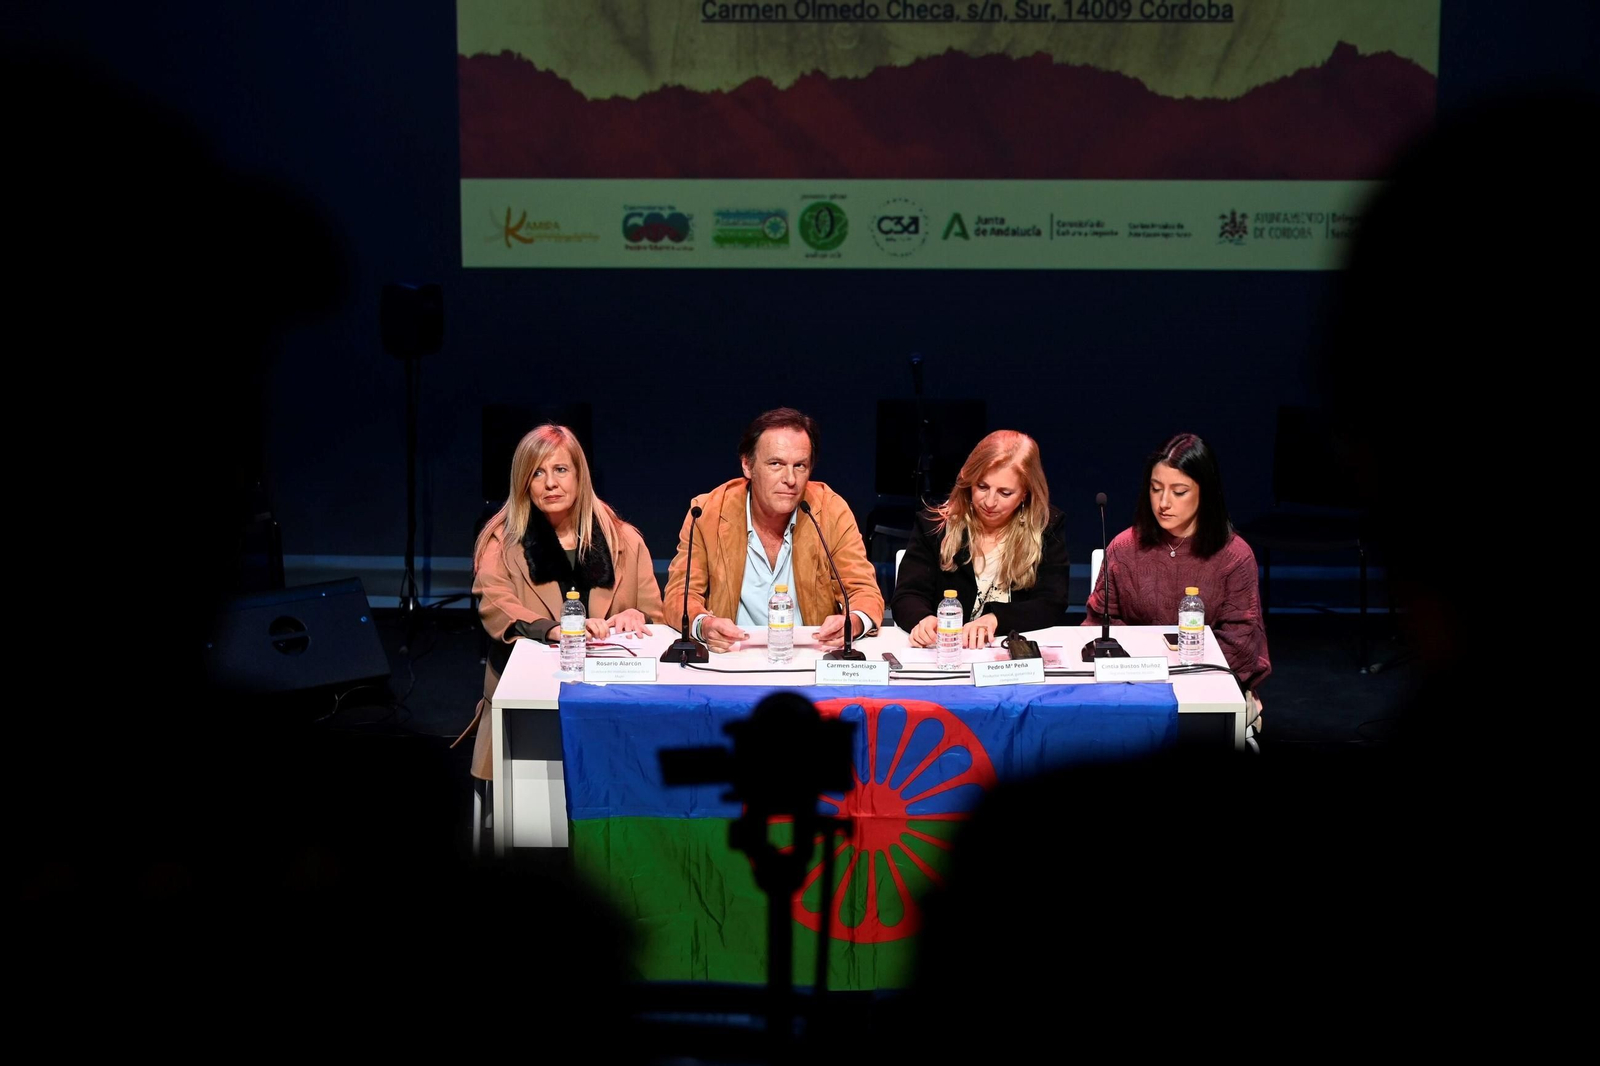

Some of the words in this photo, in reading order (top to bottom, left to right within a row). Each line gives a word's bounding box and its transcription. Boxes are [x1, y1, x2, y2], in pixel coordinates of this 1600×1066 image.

[702, 0, 787, 20] Carmen
[794, 0, 880, 20] Olmedo
[886, 0, 961, 22] Checa,
[967, 0, 1008, 22] s/n,
[1014, 0, 1057, 22] Sur,
[1065, 0, 1132, 20] 14009
[1139, 0, 1234, 20] Córdoba
[974, 215, 1006, 226] Junta
[974, 226, 988, 237] de
[989, 226, 1042, 237] Andalucía
[851, 662, 877, 670] Santiago
